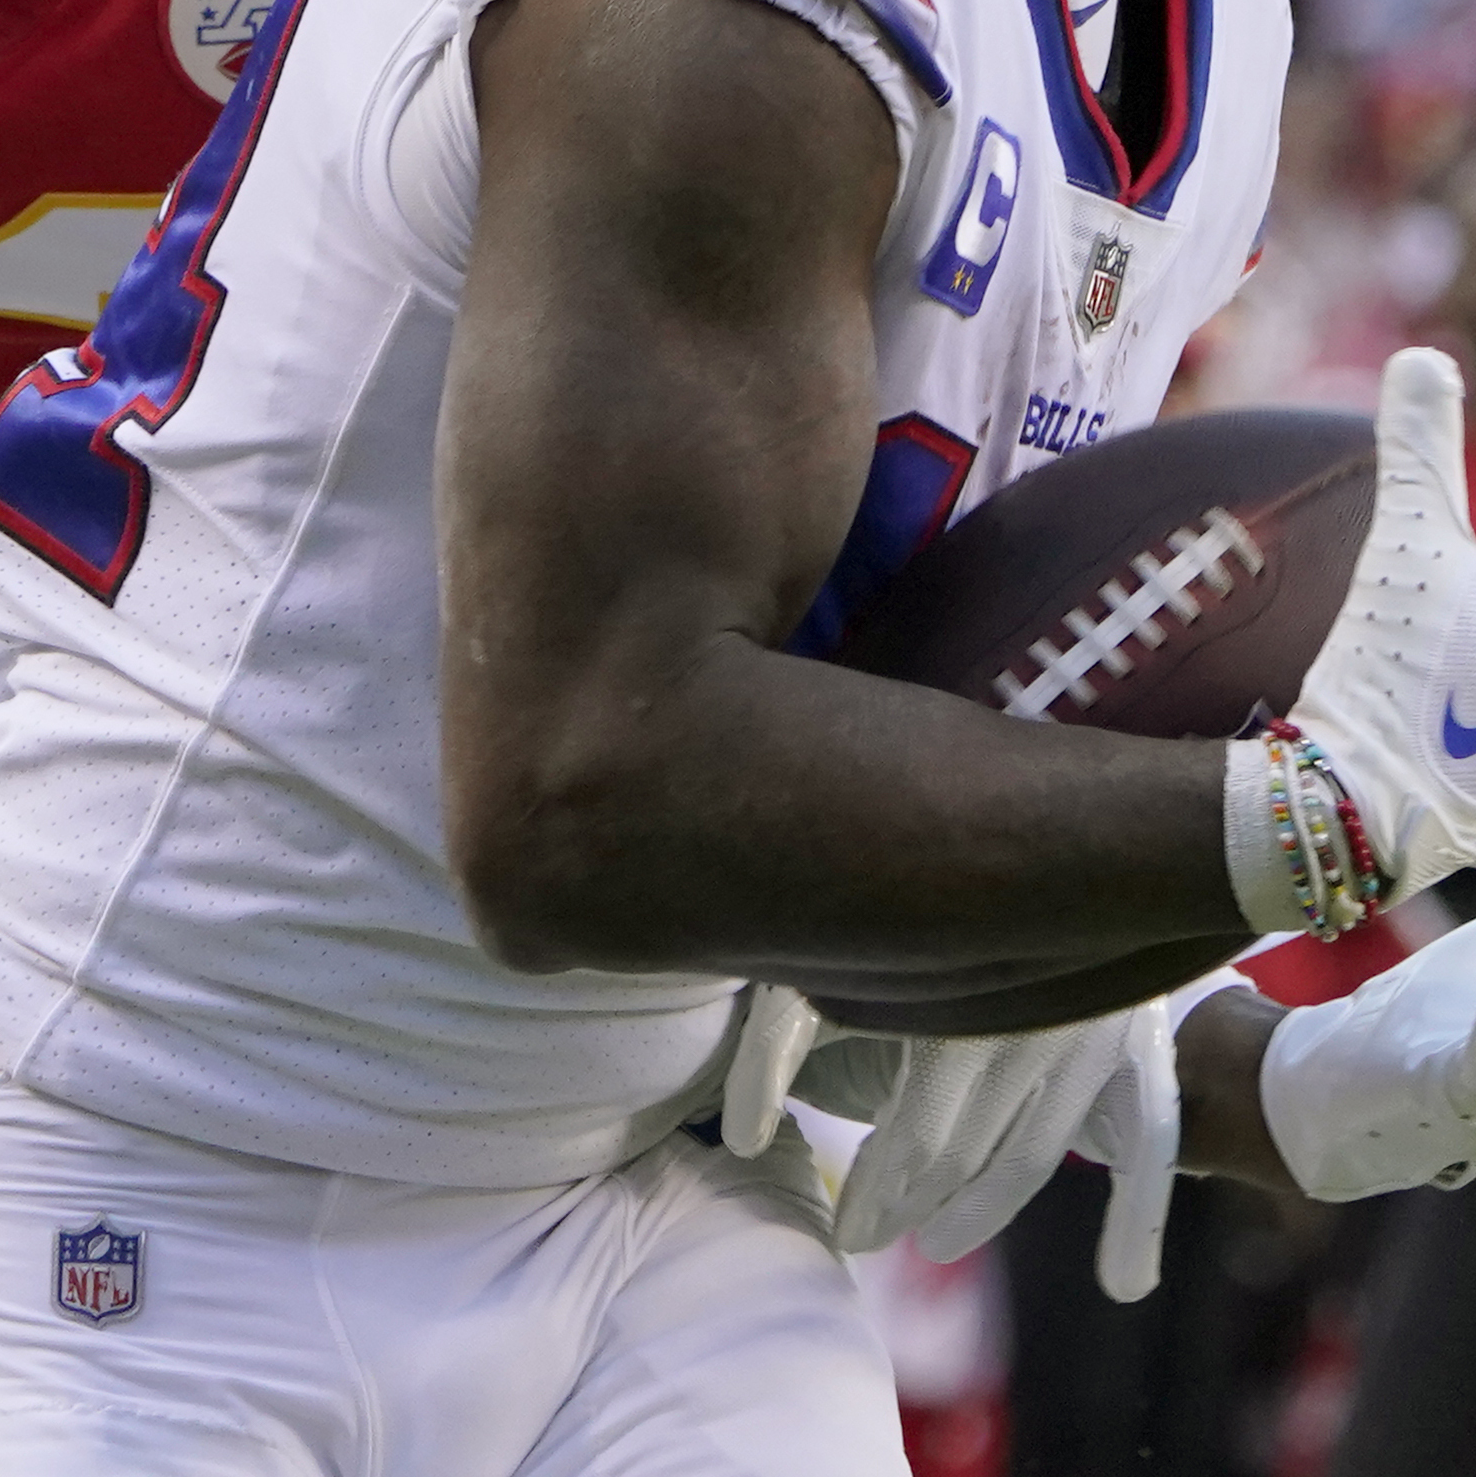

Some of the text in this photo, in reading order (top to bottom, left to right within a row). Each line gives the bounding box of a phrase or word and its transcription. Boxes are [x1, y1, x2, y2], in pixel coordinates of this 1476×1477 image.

[954, 130, 1018, 268] C
[1084, 272, 1117, 322] NFL
[1018, 392, 1107, 457] BILLS
[64, 1266, 131, 1313] NFL
